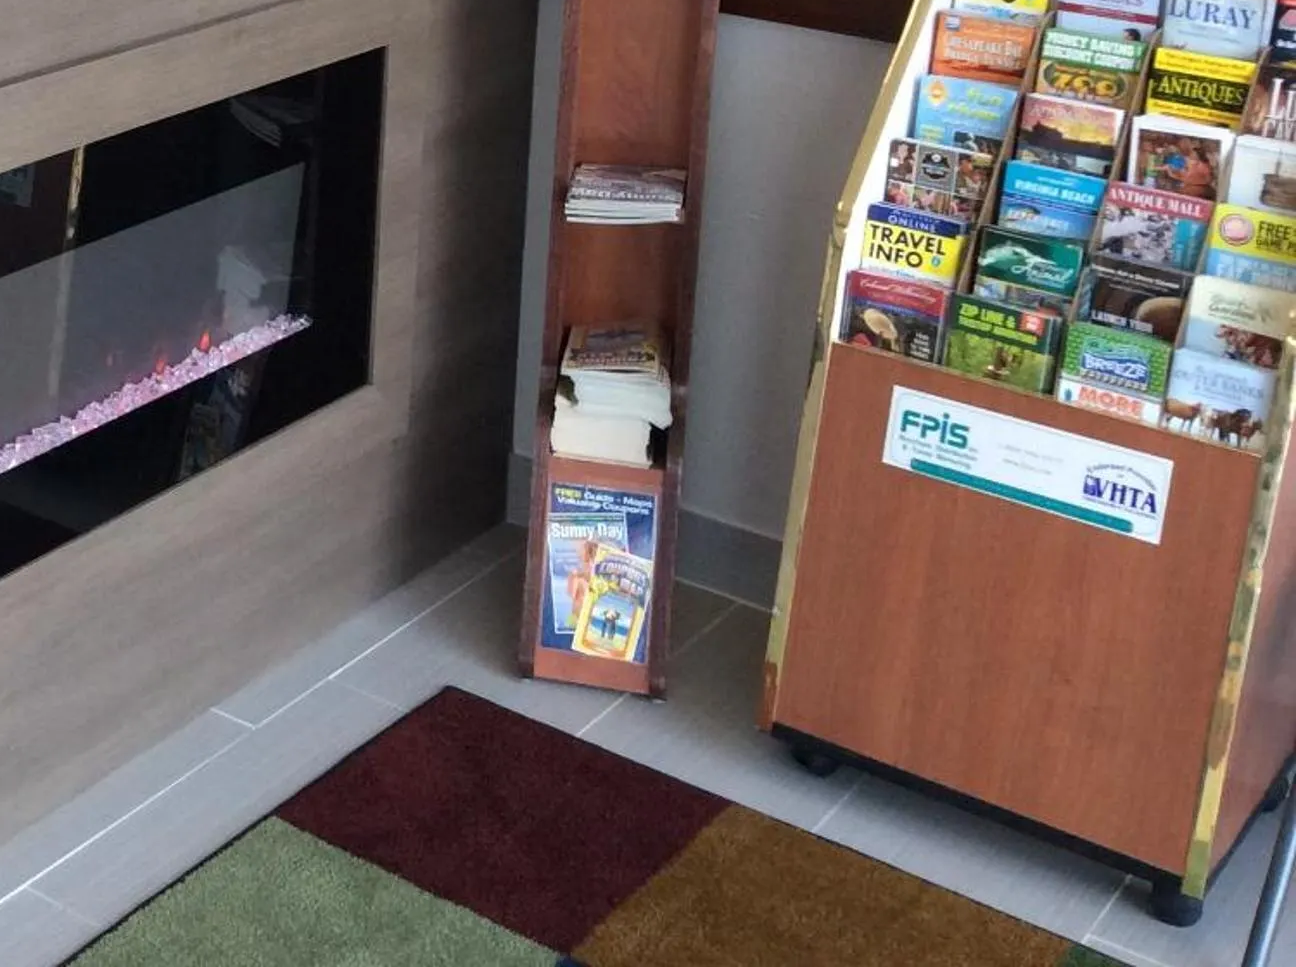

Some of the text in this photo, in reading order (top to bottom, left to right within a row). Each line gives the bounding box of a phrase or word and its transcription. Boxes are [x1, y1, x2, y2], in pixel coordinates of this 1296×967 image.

[1158, 75, 1245, 106] ANTIQUES
[1110, 187, 1203, 218] ANTIQUE MALL
[887, 214, 936, 234] ONLINE
[1258, 220, 1292, 240] FREE
[870, 223, 946, 256] TRAVEL
[869, 242, 923, 268] INFO
[1078, 386, 1142, 413] MORE
[1091, 476, 1157, 514] VHTA
[551, 522, 623, 541] Sunny Day
